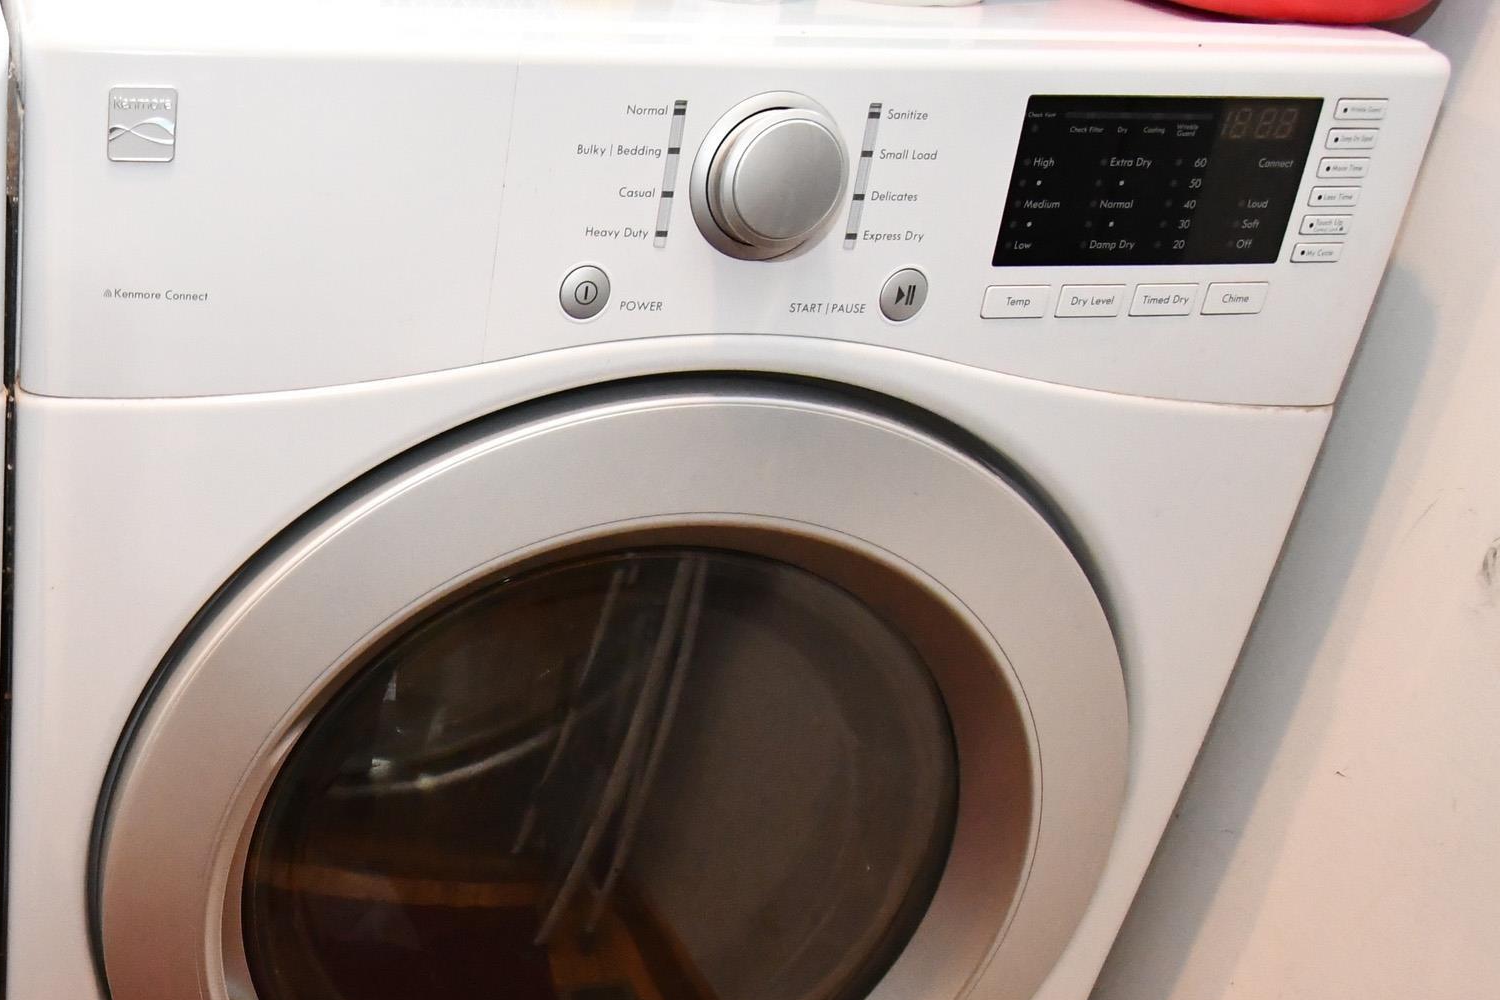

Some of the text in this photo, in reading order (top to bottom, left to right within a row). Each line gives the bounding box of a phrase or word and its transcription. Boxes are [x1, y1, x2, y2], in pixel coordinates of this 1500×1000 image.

[626, 104, 669, 116] Normal
[887, 108, 929, 121] Sanitize
[577, 144, 606, 156] Bulky
[617, 144, 662, 158] Bedding
[879, 149, 938, 161] Small Load
[1032, 157, 1055, 169] High
[1109, 157, 1152, 168] Extra Dry
[1194, 157, 1208, 168] 60
[1258, 158, 1294, 168] Connect
[1188, 178, 1202, 189] 50
[618, 187, 656, 198] Casual
[870, 190, 918, 201] Delicates
[1023, 200, 1061, 209] Medium
[1099, 200, 1134, 209] Normal
[1183, 199, 1197, 209] 40
[1247, 199, 1269, 209] Loud
[1178, 219, 1191, 229] 30
[1241, 219, 1260, 229] Soft
[585, 226, 649, 240] Heavy Duty
[862, 230, 925, 242] Express Dry
[1014, 240, 1032, 250] Low
[1089, 239, 1136, 251] Damp Dry
[1172, 239, 1186, 249] 20
[1236, 239, 1252, 249] Off
[114, 288, 209, 301] Kenmore Connect
[1142, 294, 1190, 306] Timed Dry
[1221, 293, 1250, 303] Chime
[619, 300, 663, 312] POWER
[1006, 296, 1031, 308] Temp
[1070, 295, 1115, 307] Dry Level
